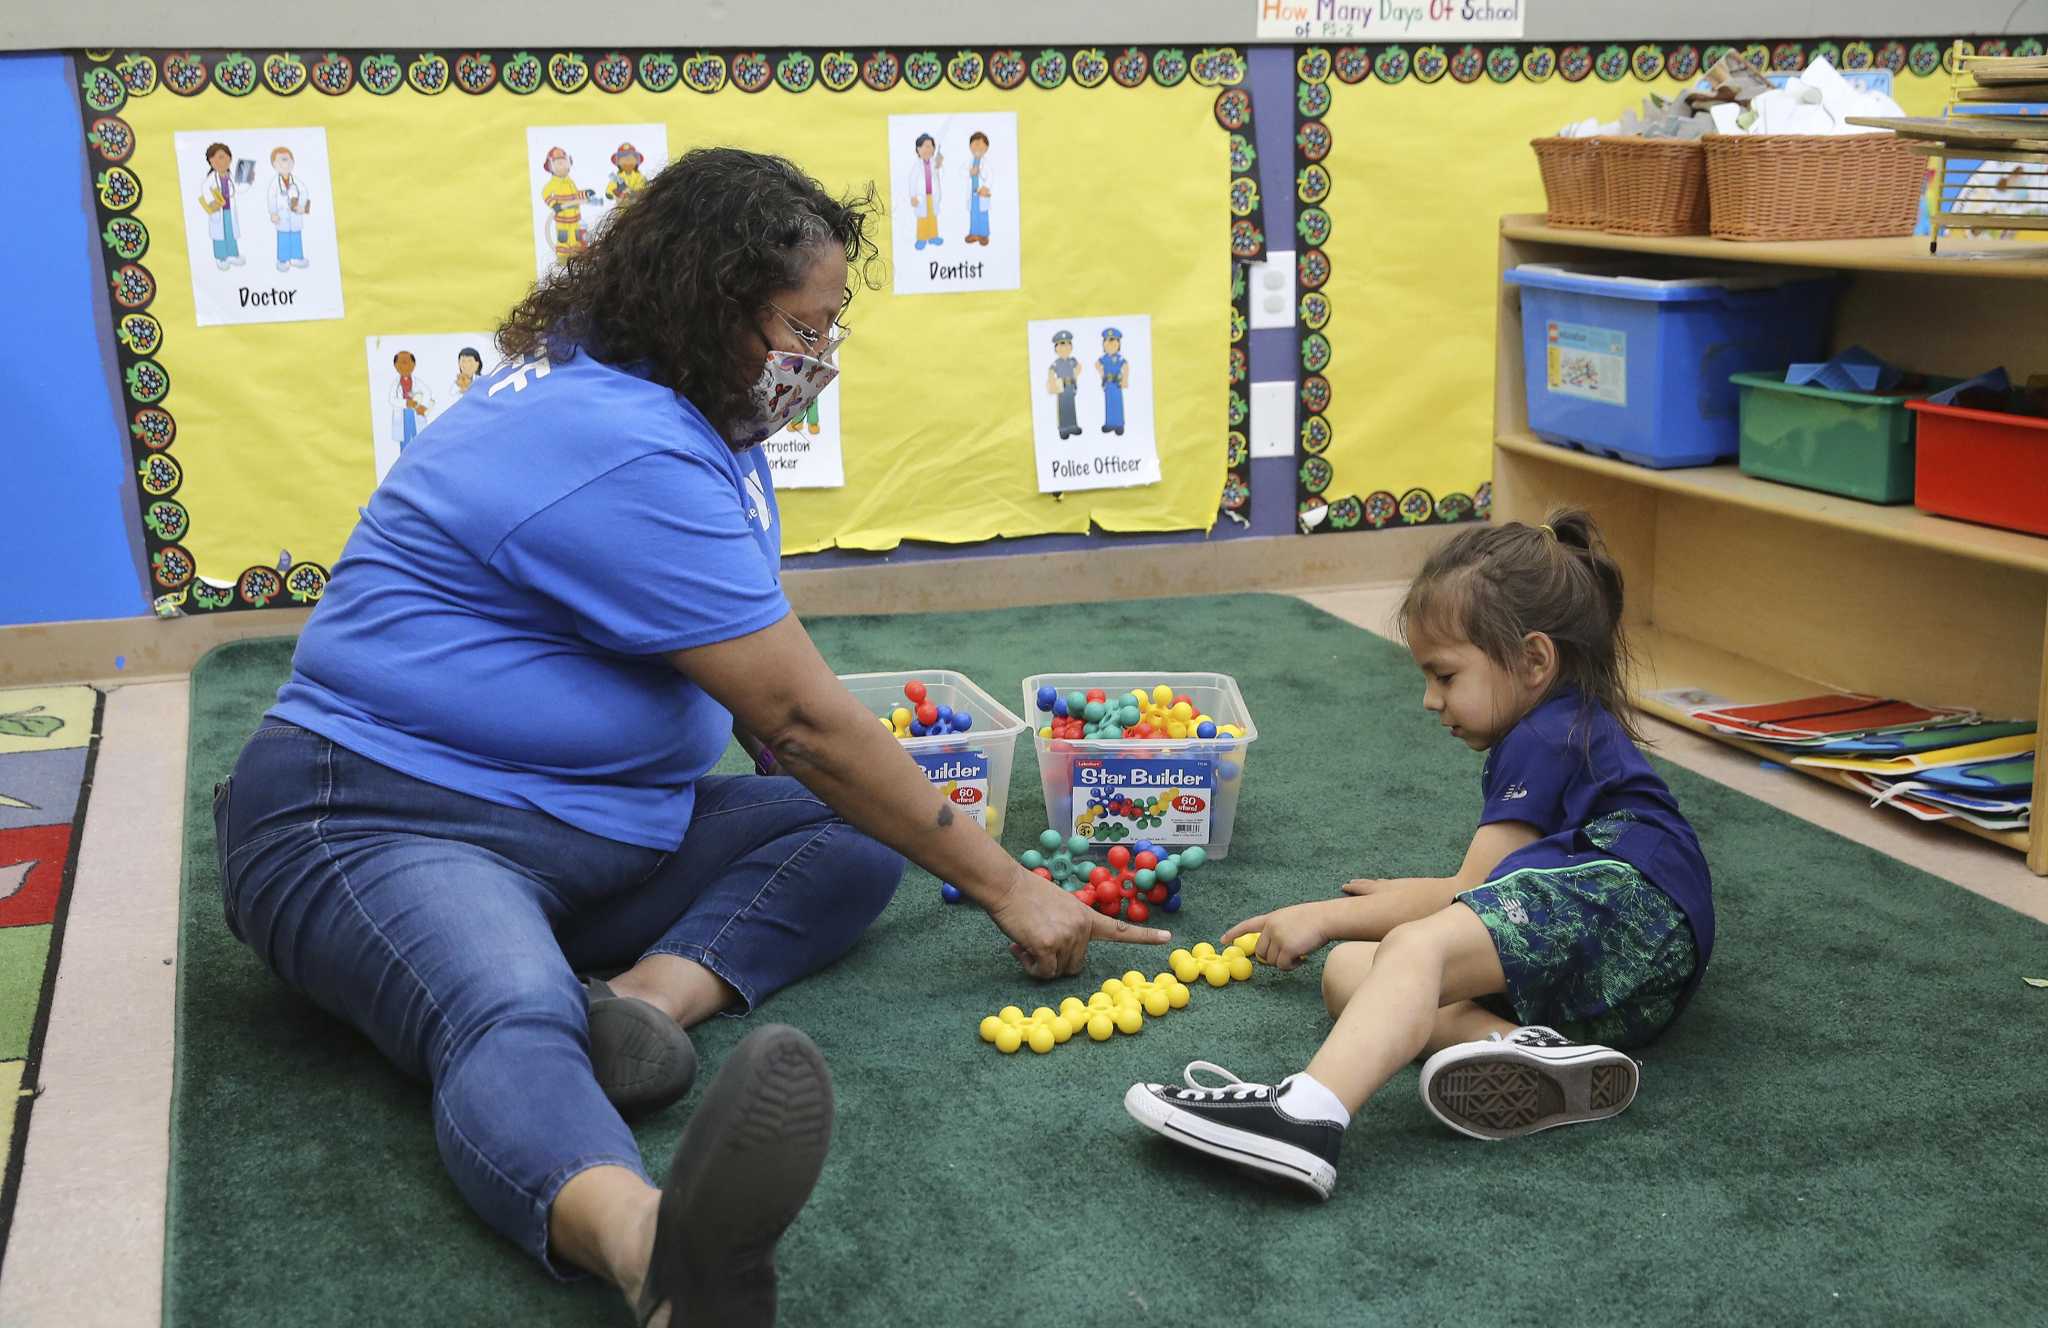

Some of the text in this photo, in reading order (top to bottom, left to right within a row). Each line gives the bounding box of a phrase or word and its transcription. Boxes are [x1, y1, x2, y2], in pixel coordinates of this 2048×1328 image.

[1263, 0, 1307, 20] How
[1317, 0, 1372, 28] Many
[1379, 0, 1423, 32] Days
[1461, 0, 1519, 21] School
[1295, 21, 1310, 38] of
[929, 260, 984, 280] Dentist
[239, 286, 297, 308] Doctor
[768, 455, 799, 470] orker
[1052, 455, 1142, 478] Police Officer
[1081, 767, 1204, 786] Star Builder
[959, 788, 974, 797] 60
[1181, 796, 1196, 805] 60
